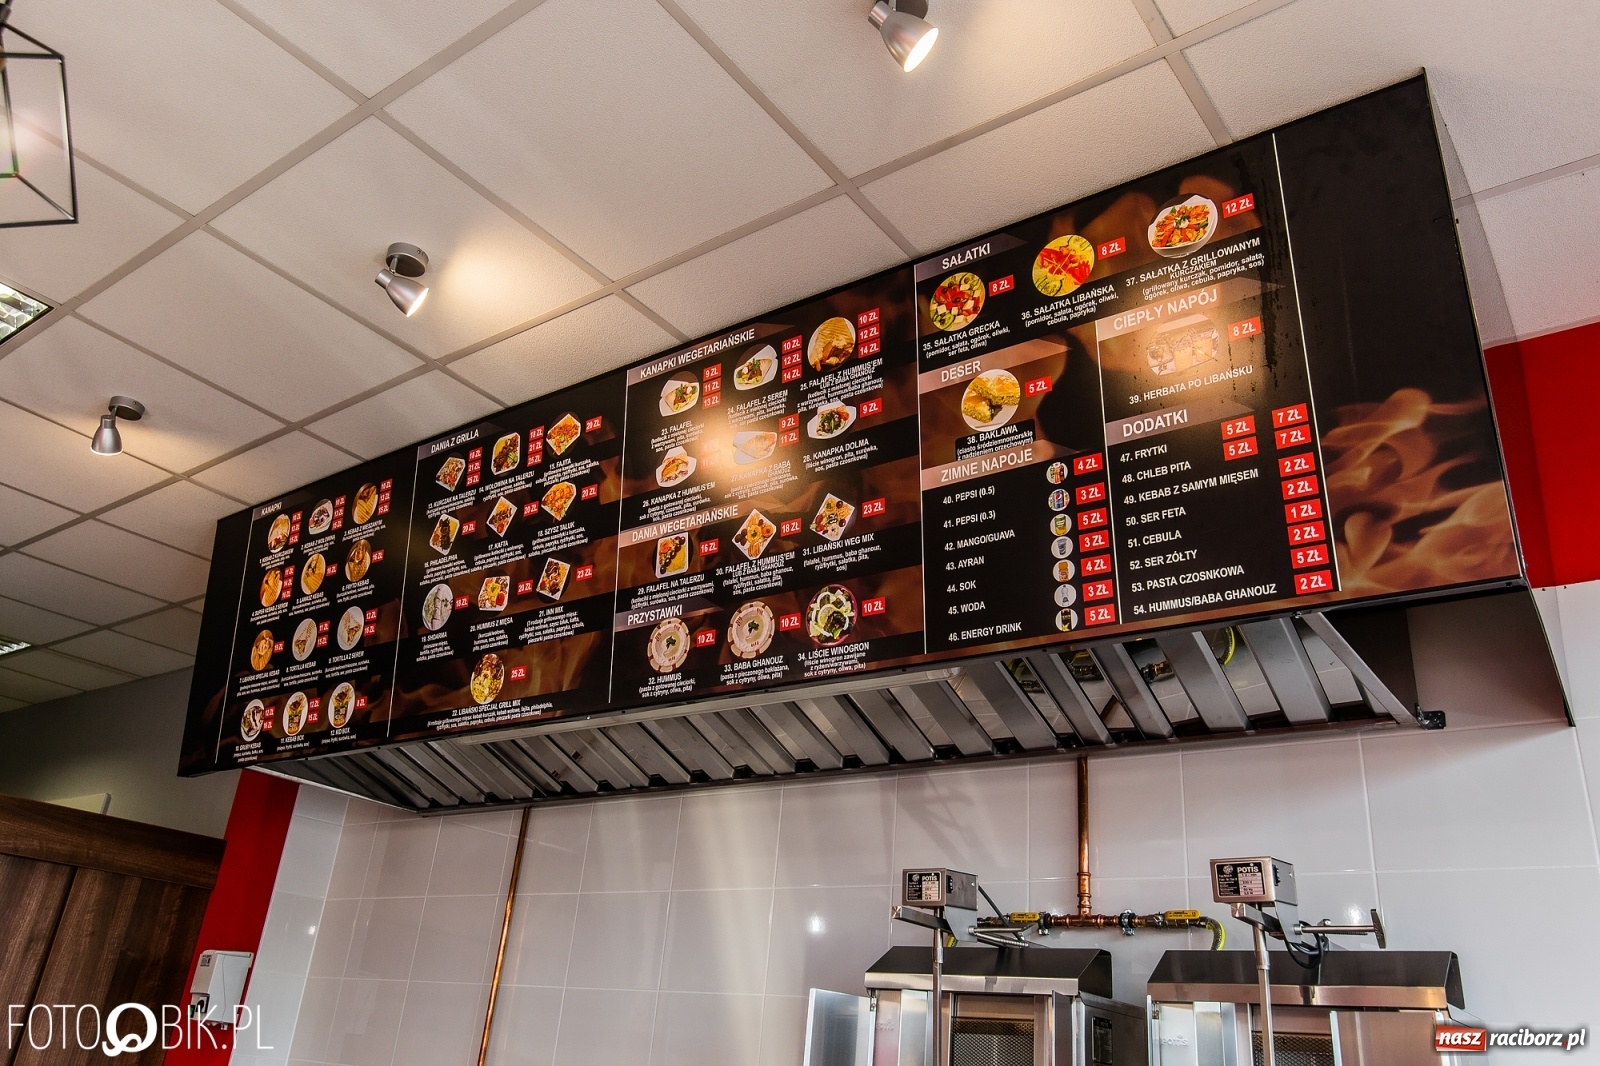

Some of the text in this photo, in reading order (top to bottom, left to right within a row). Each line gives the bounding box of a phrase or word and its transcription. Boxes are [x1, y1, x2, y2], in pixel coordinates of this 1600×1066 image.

[1225, 197, 1252, 213] 12 ZŁ
[942, 242, 990, 269] SAŁATKI
[1125, 236, 1260, 286] 37. SAŁATKA Z GRILLOWANYM
[1169, 259, 1216, 279] KURCZAKIEM
[992, 279, 1010, 292] 8 ZŁ
[1021, 284, 1114, 320] 36. SAŁATKA LIBAŃSKA
[1112, 285, 1217, 330] CIEPŁY NAPÓJ
[922, 320, 1000, 351] 35. SAŁATKA GRECKA
[1233, 321, 1256, 336] 8 ZŁ
[640, 328, 754, 378] KANAPKI WEGETARIAŃSKIE
[800, 357, 882, 391] 25. FALAFEL Z HUMMUS'EM
[941, 360, 981, 382] DESER
[1029, 380, 1047, 393] 5 ZŁ
[1128, 364, 1252, 404] 39. HERBATA PO LIBAŃSKU
[736, 398, 761, 411] FALAFEL
[761, 395, 766, 403] Z
[767, 388, 788, 402] SEREM
[669, 420, 692, 433] FALAFEL
[1122, 408, 1187, 437] DODATKI
[1226, 420, 1250, 435] 5 ZŁ
[430, 428, 479, 453] DANIA Z GRILLA
[966, 424, 1018, 444] 38. BAKLAWA
[802, 438, 869, 462] 28. KANAPKA DOLMA
[1120, 444, 1167, 462] 47. FRYTKI
[941, 447, 1033, 482] ZIMNE NAPOJE
[1077, 457, 1098, 470] 4 ZŁ
[1121, 460, 1191, 483] 48. CHLEB PITA
[1284, 457, 1309, 472] 2 ZŁ
[942, 485, 995, 504] 40. PEPSI (0.5)
[1123, 468, 1258, 504] 49. KEBAB Z SAMYM MIĘSEM
[863, 501, 883, 514] 23 ZŁ
[1125, 506, 1186, 526] 50. SER FETA
[632, 504, 738, 541] DANIA WEGETARIAŃSKIE
[943, 509, 995, 528] 41. PEPSI (0.3)
[802, 532, 874, 556] 31. LIBAŃSKI WEG MIX
[944, 529, 1015, 551] 42. MANGO/GUAVA
[1127, 529, 1182, 548] 51. CEBULA
[715, 551, 795, 576] 30. FALAFEL Z HUMMUS'EM
[945, 555, 984, 570] 43. AYRAN
[637, 573, 704, 595] 29. FALAFEL NA TALERZU
[946, 579, 976, 593] 44. SOK
[1131, 564, 1244, 592] 53. PASTA CZOSNKOWA
[947, 600, 985, 614] 45. WODA
[1133, 583, 1277, 615] 54. HUMMUS/BABA GHANOUZ
[627, 604, 682, 625] PRZYSTAWKI
[948, 621, 1022, 641] 46. ENERGY DRINK
[797, 641, 869, 661] 34. LIŚCIE WINOGRON
[723, 655, 783, 672] 33. BABA GHANOUZ
[648, 672, 681, 685] 32. HUMMUS
